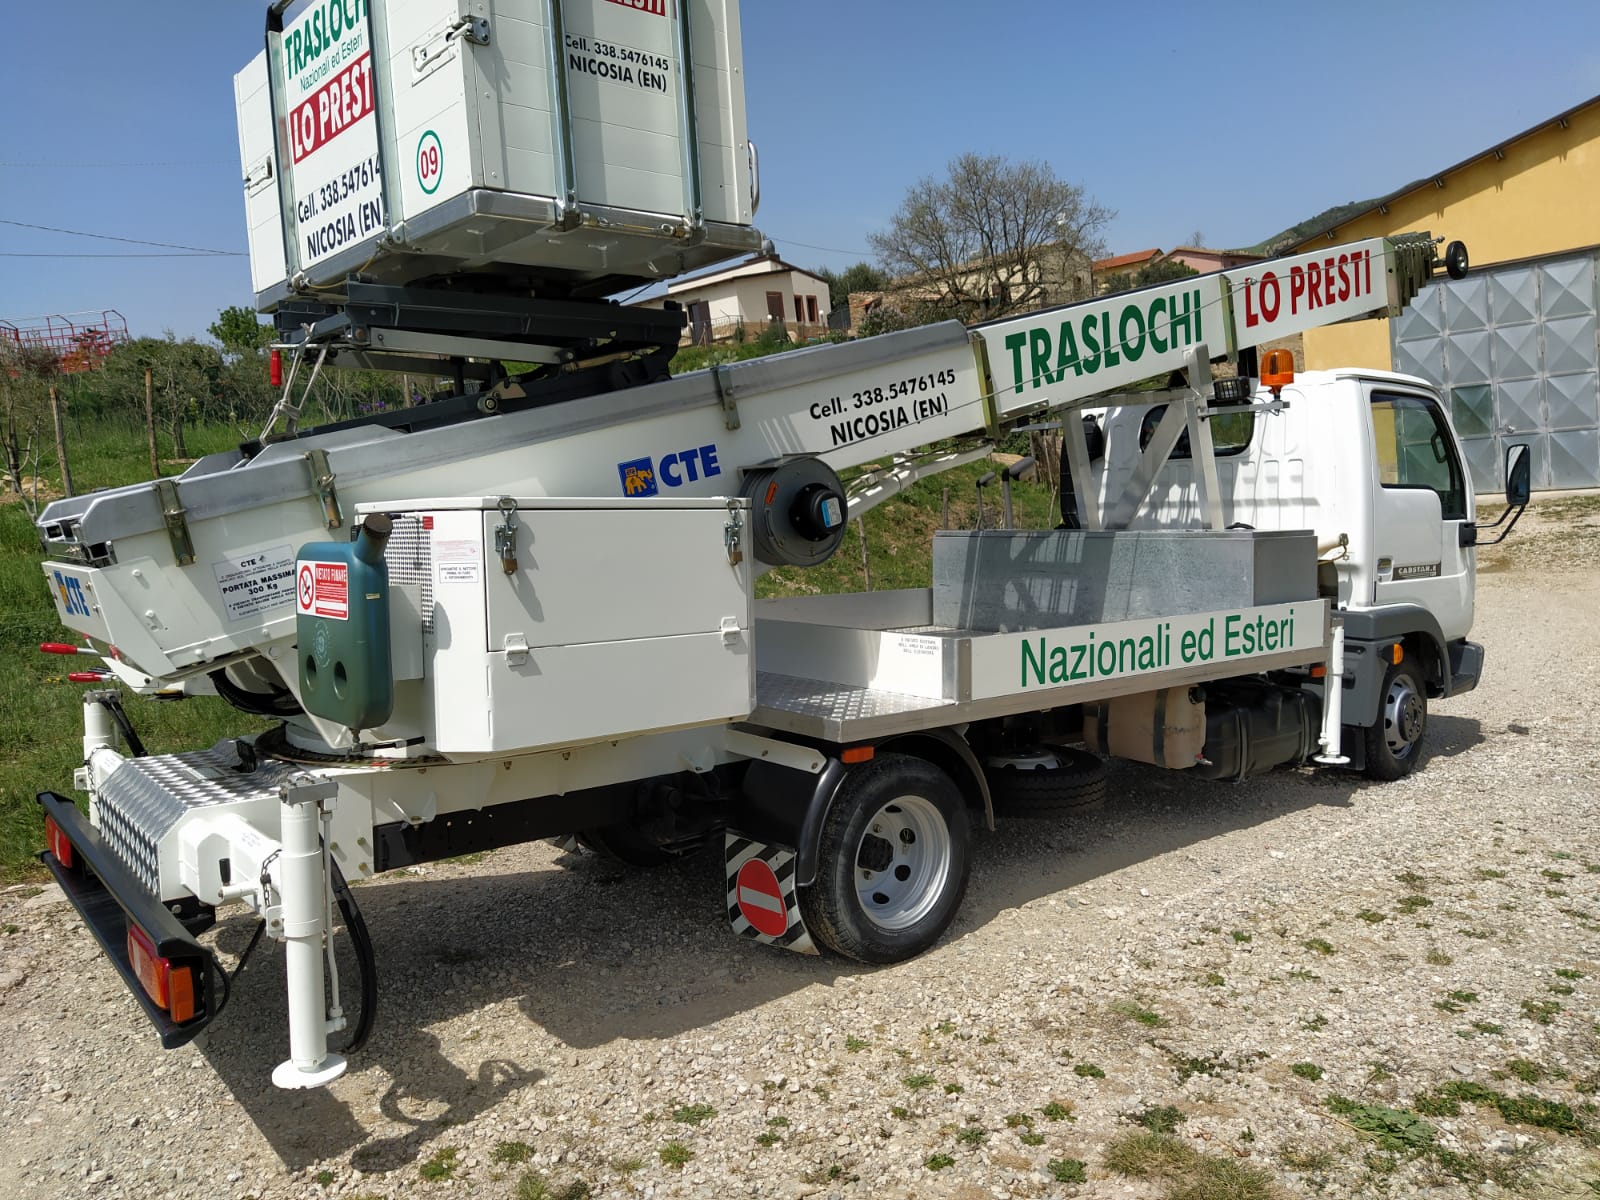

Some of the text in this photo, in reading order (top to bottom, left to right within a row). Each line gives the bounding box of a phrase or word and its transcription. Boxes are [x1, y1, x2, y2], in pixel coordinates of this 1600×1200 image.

[300, 28, 363, 93] Nazionali ed Esteri
[565, 35, 669, 70] Cell. 338.5476145
[569, 54, 667, 93] NICOSIA (EN)
[293, 55, 371, 159] LO PREST
[421, 146, 438, 179] 09
[298, 192, 318, 223] Cell.
[307, 212, 356, 260] NICOSIA
[1245, 249, 1371, 328] LO PRESTI
[1005, 289, 1202, 394] TRASLOCHI
[810, 369, 955, 419] Cell. 338.5476145
[830, 392, 948, 445] NICOSIA (EN)
[659, 444, 721, 487] CTE
[241, 559, 256, 567] CTE
[65, 576, 91, 616] CTE
[222, 580, 258, 594] PORTATA
[248, 586, 264, 595] 300
[1021, 609, 1294, 687] Nazionali ed Esteri
